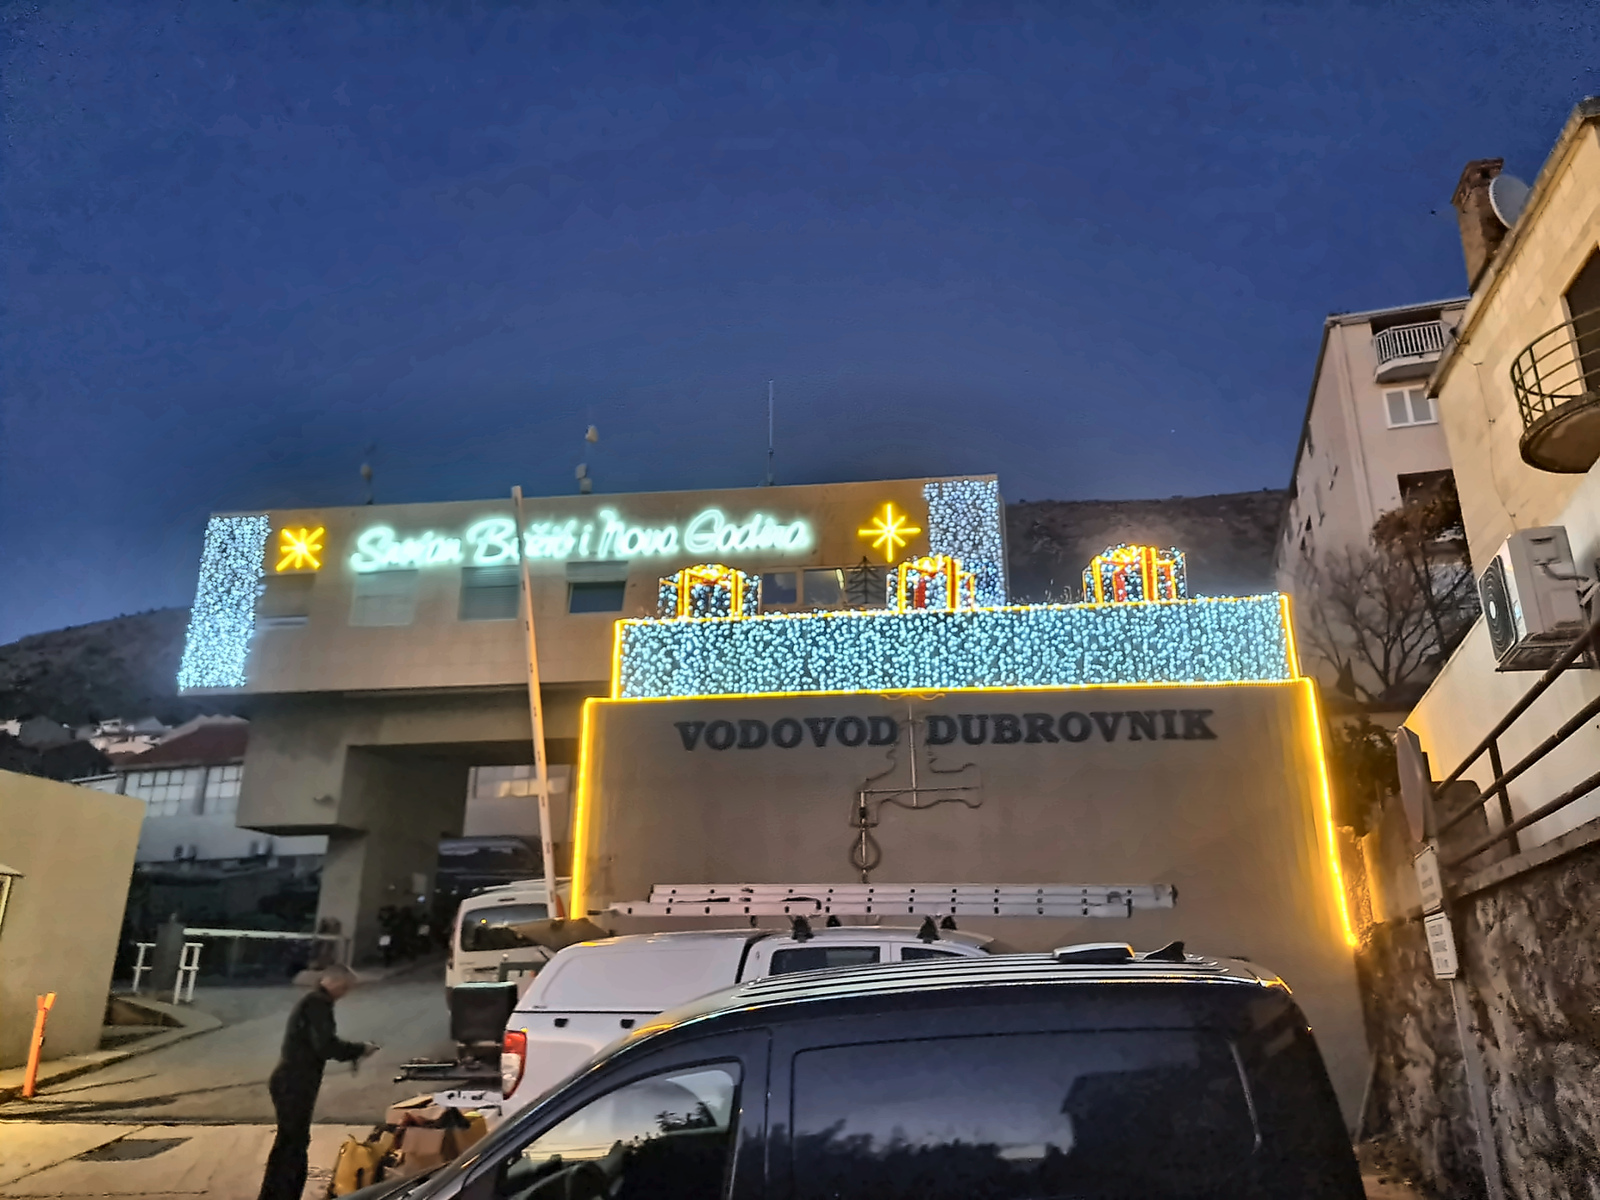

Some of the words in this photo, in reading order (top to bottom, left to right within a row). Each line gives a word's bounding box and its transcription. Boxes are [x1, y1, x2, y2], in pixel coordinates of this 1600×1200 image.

[578, 523, 593, 557] i
[597, 509, 680, 558] Nova
[685, 508, 811, 553] Godina
[673, 715, 898, 751] VODOVOD
[925, 709, 1218, 745] DUBROVNIK
